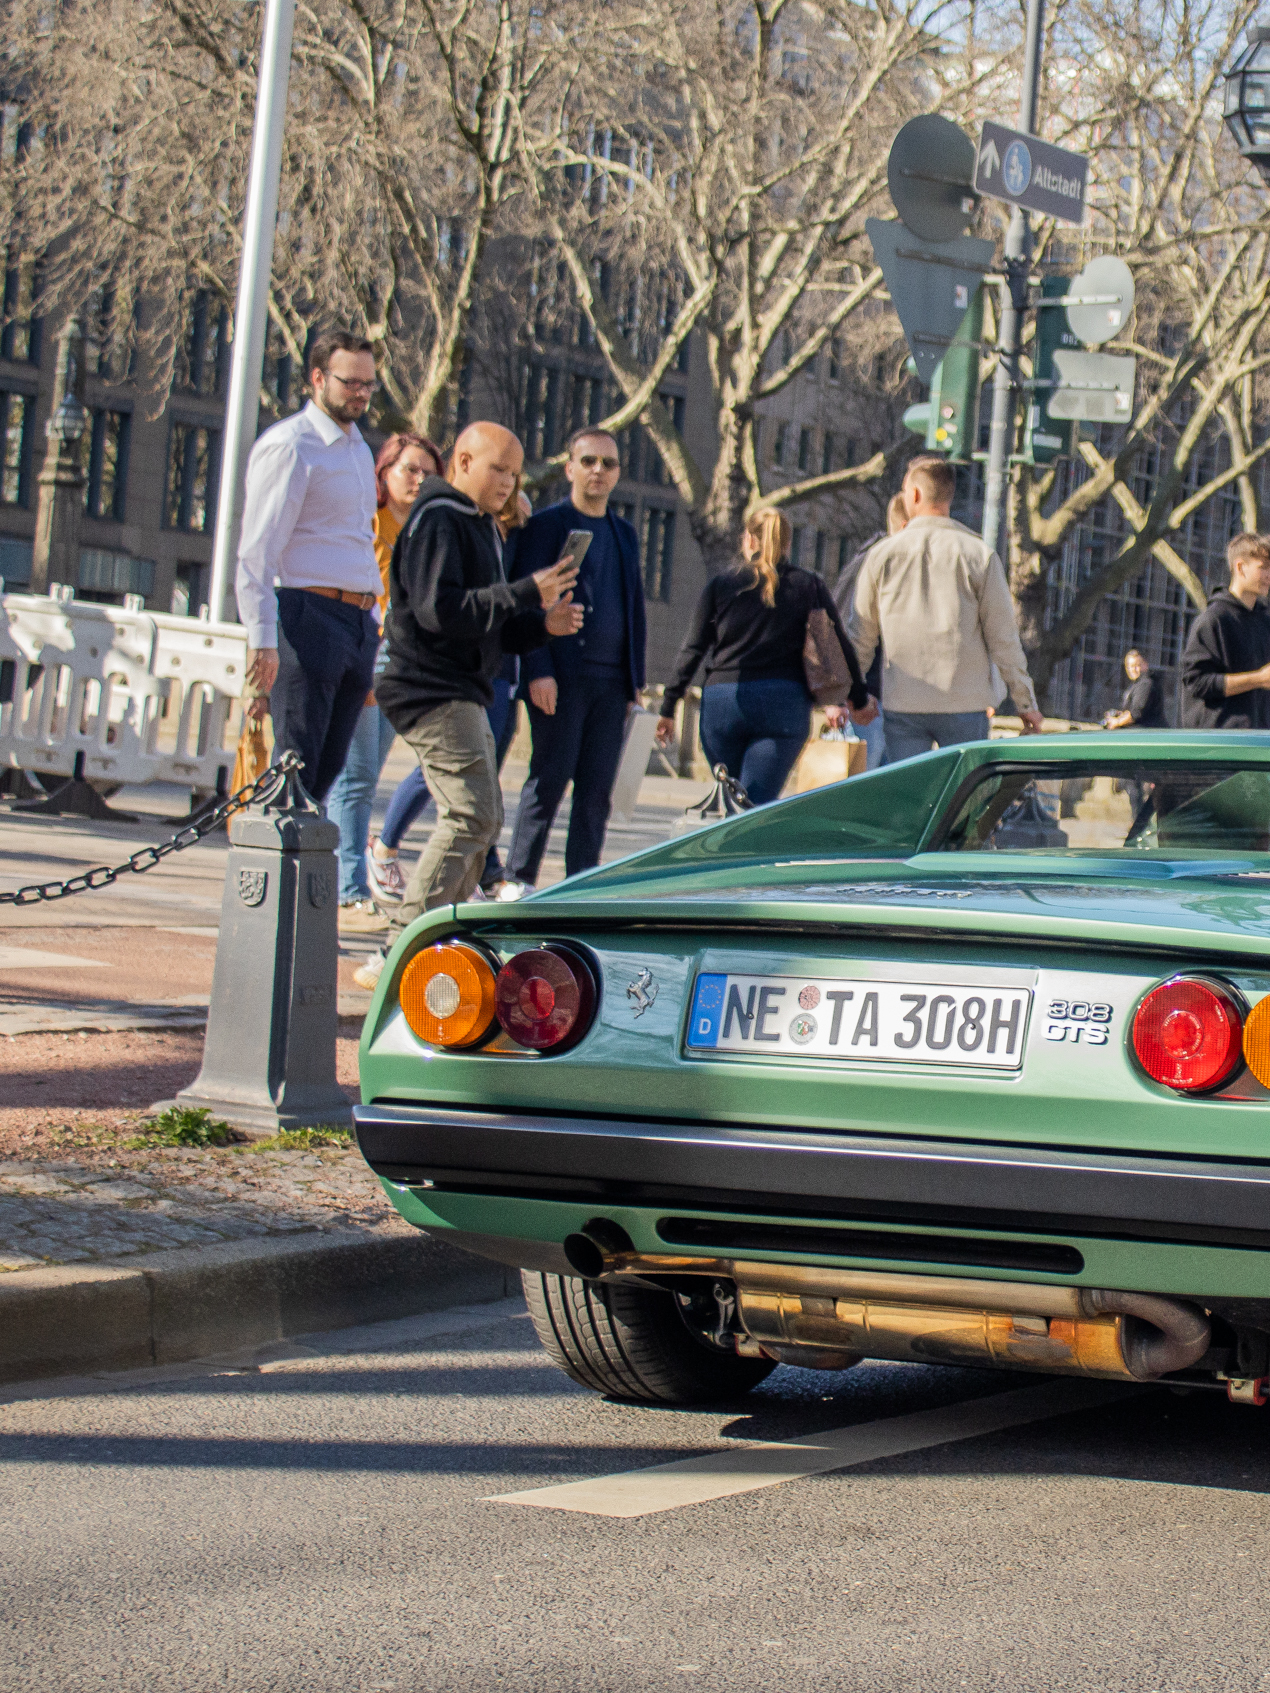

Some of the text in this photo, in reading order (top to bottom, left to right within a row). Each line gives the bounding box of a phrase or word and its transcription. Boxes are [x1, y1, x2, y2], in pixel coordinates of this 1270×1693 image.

[1034, 164, 1081, 200] Altstadt
[722, 983, 1022, 1055] NE TA 308H
[1047, 1000, 1114, 1024] 308
[698, 1018, 712, 1035] D
[1041, 1020, 1110, 1045] GTS
